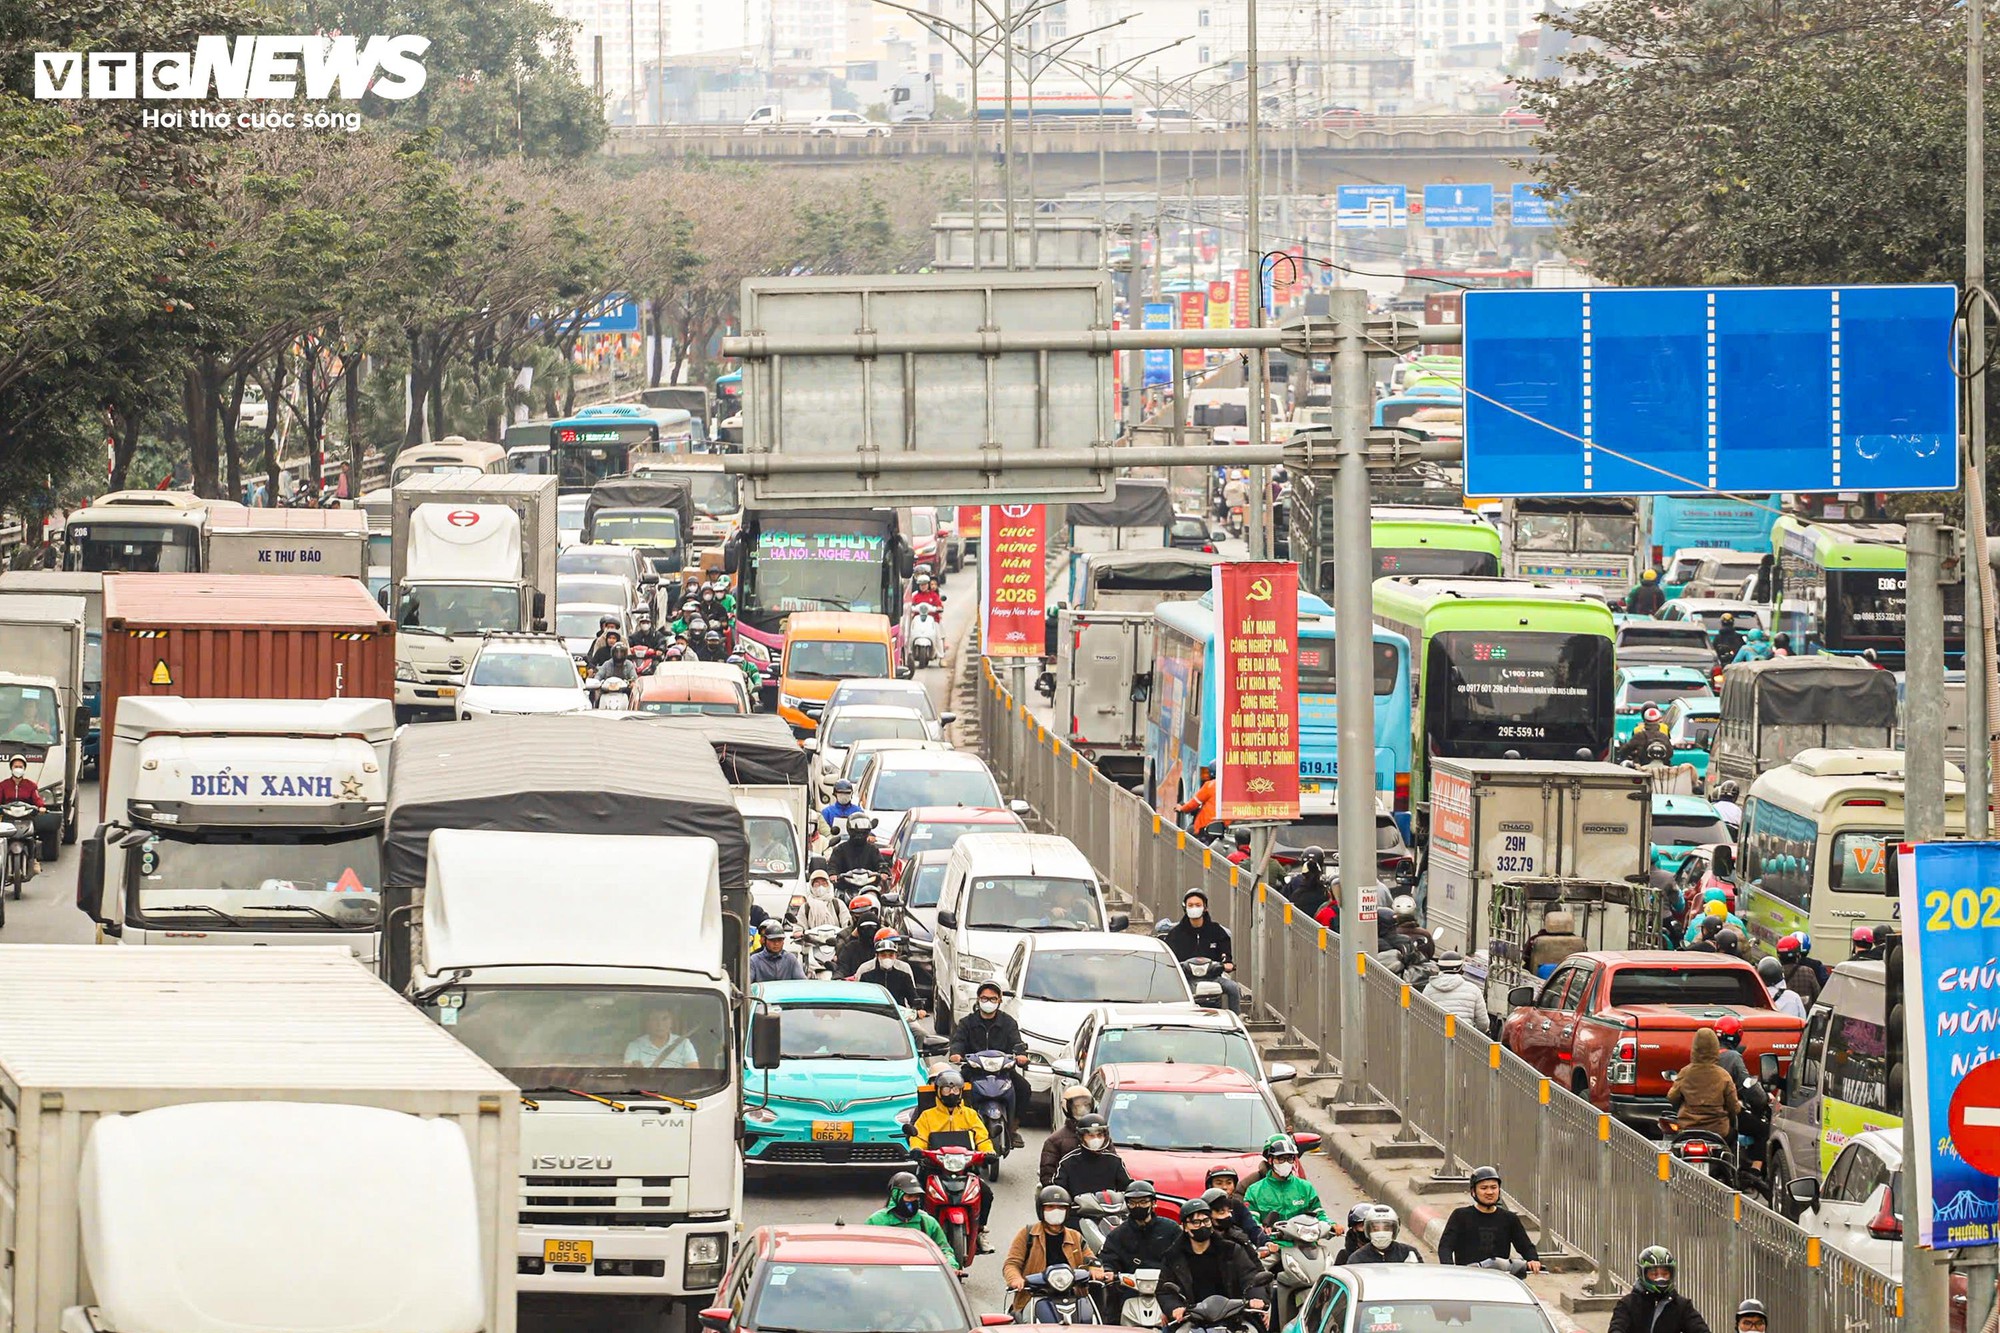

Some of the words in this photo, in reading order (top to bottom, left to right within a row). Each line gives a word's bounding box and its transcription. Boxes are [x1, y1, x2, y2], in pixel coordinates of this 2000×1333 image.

[999, 526, 1036, 537] CHÚC
[996, 542, 1037, 553] MỪNG
[258, 550, 272, 563] XE
[275, 550, 297, 563] THƯ
[300, 546, 321, 562] BÁO
[853, 550, 869, 561] AN
[1001, 557, 1031, 569] NĂM
[1002, 573, 1031, 584] MỚI
[995, 588, 1037, 603] 2026
[991, 607, 1011, 618] Happy
[1011, 607, 1027, 616] New
[1027, 607, 1042, 616] Year
[1230, 637, 1248, 653] CÔNG
[1249, 676, 1266, 690] KHOA
[1466, 684, 1480, 693] 0917
[1481, 684, 1492, 693] 601
[1492, 685, 1503, 693] 298
[1241, 693, 1258, 709] CÔNG
[1498, 726, 1545, 738] 29E-559.14
[191, 766, 249, 796] BIỂN
[261, 776, 333, 797] XANH
[1232, 804, 1262, 816] PHƯỜNG
[1264, 804, 1277, 816] YÊN
[1505, 836, 1526, 851] 29H
[1497, 856, 1533, 872] 332.79
[1925, 887, 2000, 932] 202
[641, 1119, 684, 1128] FVM
[824, 1122, 842, 1132] 29E
[532, 1155, 613, 1170] ISUZU
[1948, 1221, 1990, 1243] PHƯỜNG
[558, 1241, 579, 1252] 89C
[1370, 1323, 1397, 1332] TAXI
